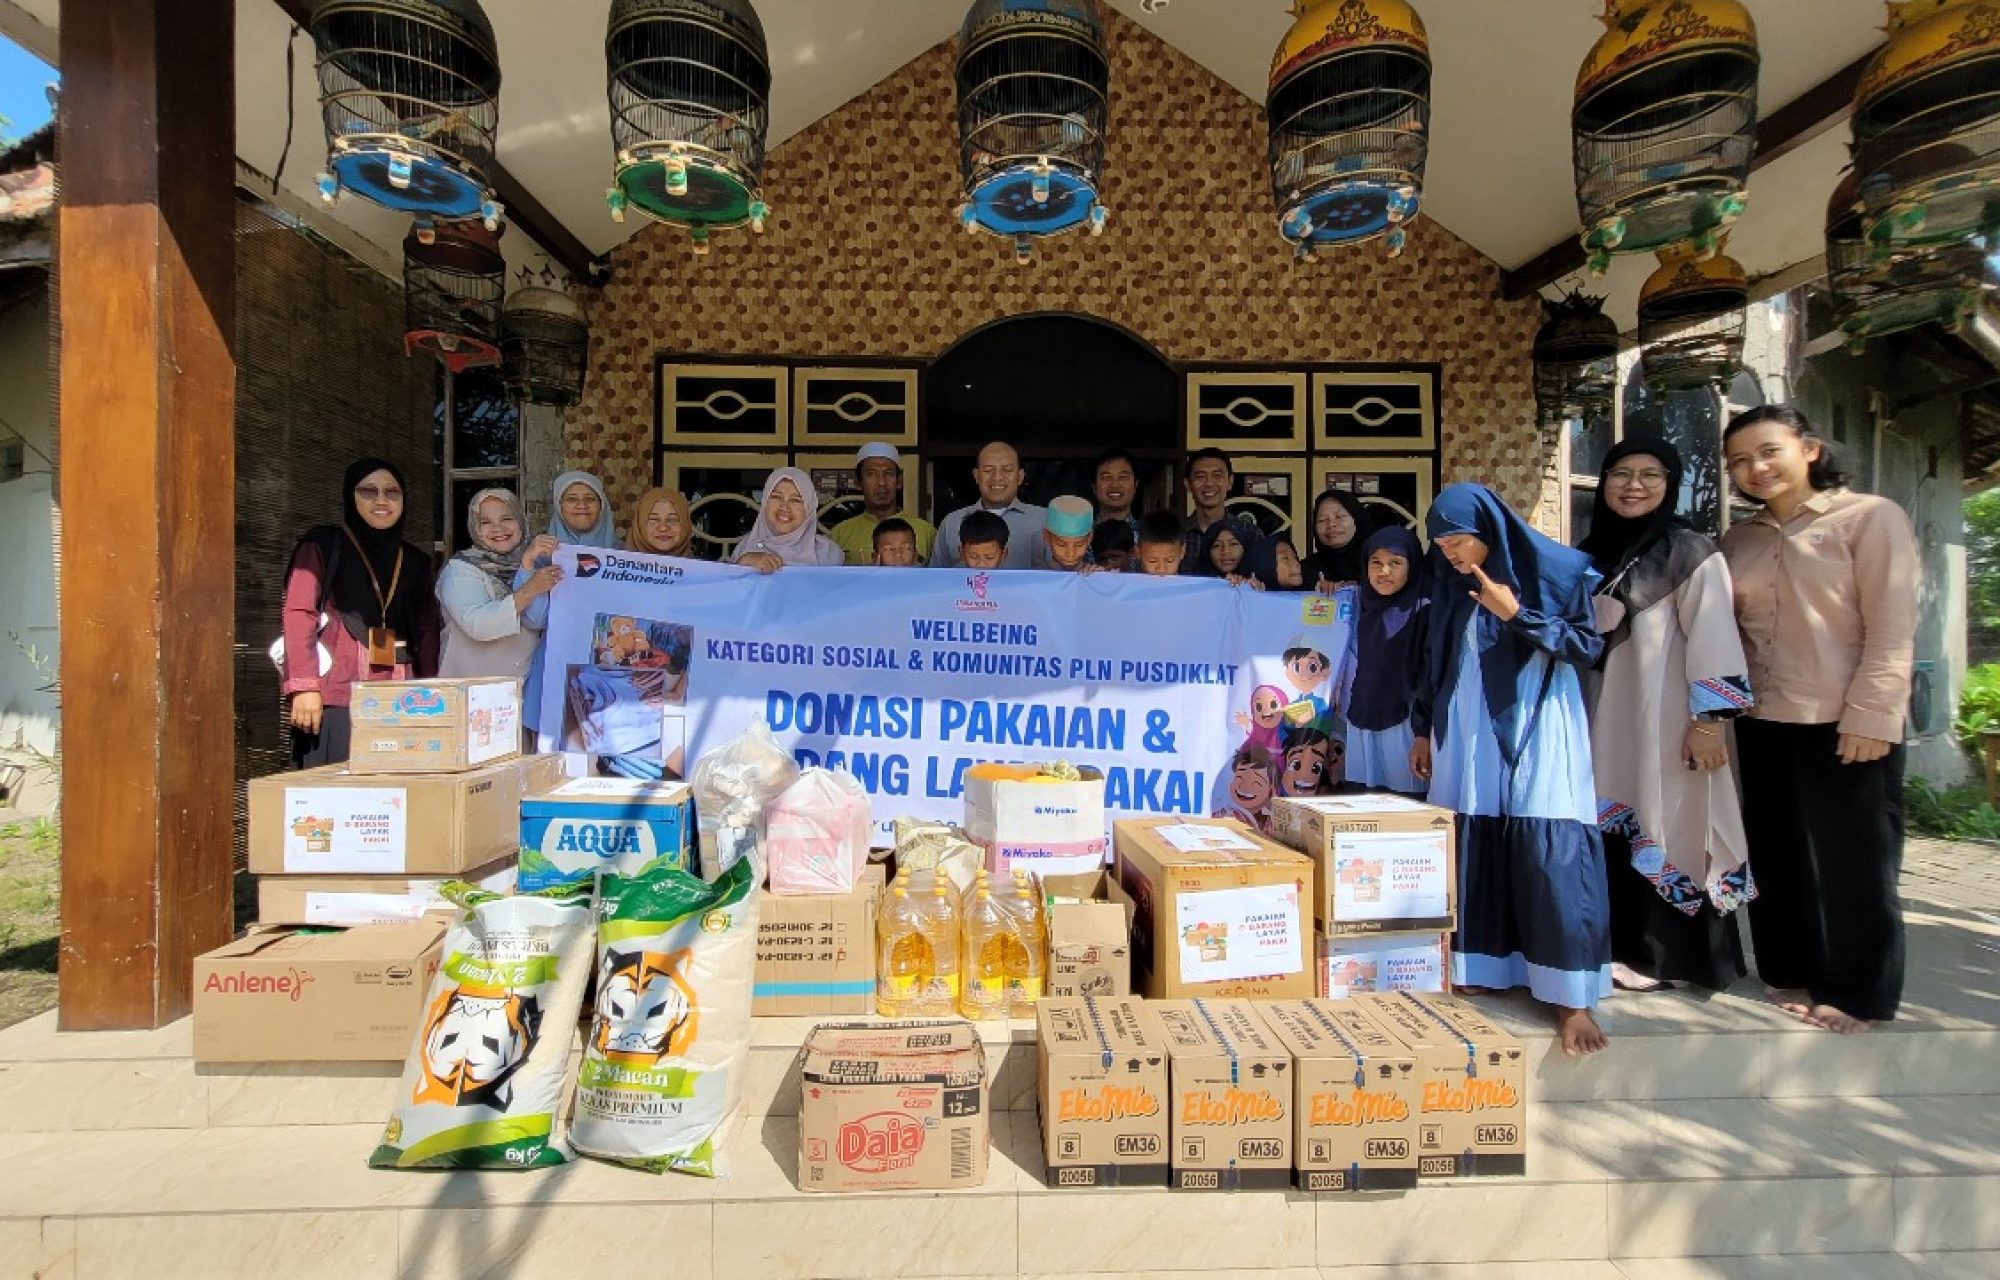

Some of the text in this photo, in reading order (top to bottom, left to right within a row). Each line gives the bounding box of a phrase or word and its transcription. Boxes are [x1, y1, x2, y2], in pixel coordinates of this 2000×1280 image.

[606, 555, 684, 577] Danantara
[911, 619, 1037, 646] WELLBEING
[707, 638, 1238, 686] KATEGORI SOSIAL & KOMUNITAS PLN PUSDIKLAT
[766, 689, 1178, 754] DONASI PAKAIAN &
[557, 824, 641, 858] AQUA
[203, 971, 292, 993] Anlene
[1057, 1083, 1159, 1123] EkoMie
[1181, 1086, 1285, 1126] EkoMie
[1420, 1077, 1519, 1114] EkoMie
[613, 1100, 684, 1116] PREMIUM
[947, 1101, 963, 1114] 12
[1308, 1088, 1409, 1127] EkoMie
[839, 1117, 924, 1164] Daia
[1064, 1137, 1156, 1153] 8 EM36
[1477, 1128, 1515, 1143] EM36
[1241, 1142, 1281, 1157] EM36
[1367, 1141, 1406, 1157] EM36
[1060, 1169, 1095, 1184] 20056
[1183, 1173, 1217, 1187] 20056
[1310, 1174, 1343, 1187] 20056
